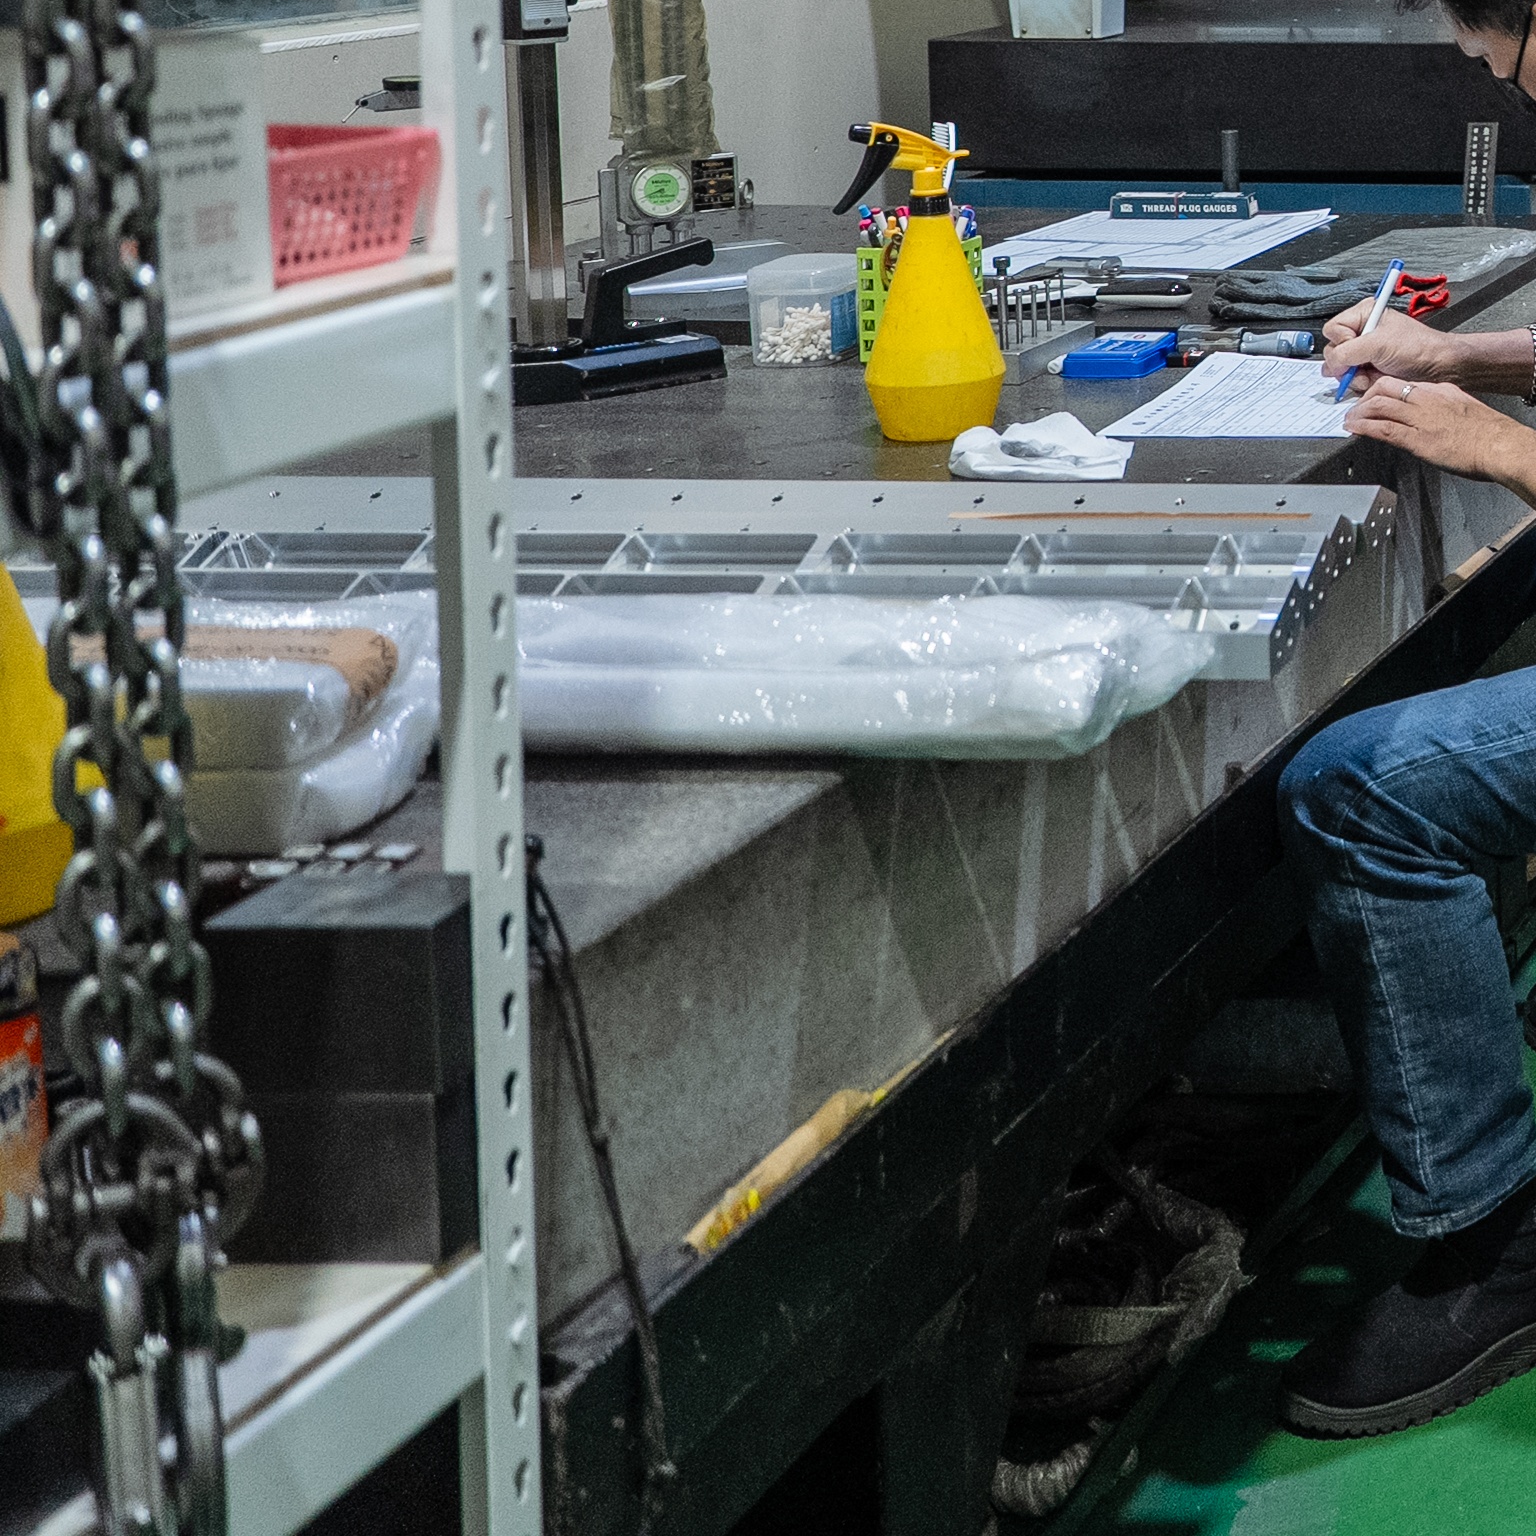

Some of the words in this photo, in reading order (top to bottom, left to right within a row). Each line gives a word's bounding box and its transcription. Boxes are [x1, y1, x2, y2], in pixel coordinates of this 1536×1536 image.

[1142, 204, 1176, 213] THREAD
[1179, 204, 1201, 213] PLUG
[1203, 204, 1238, 213] GAUGES
